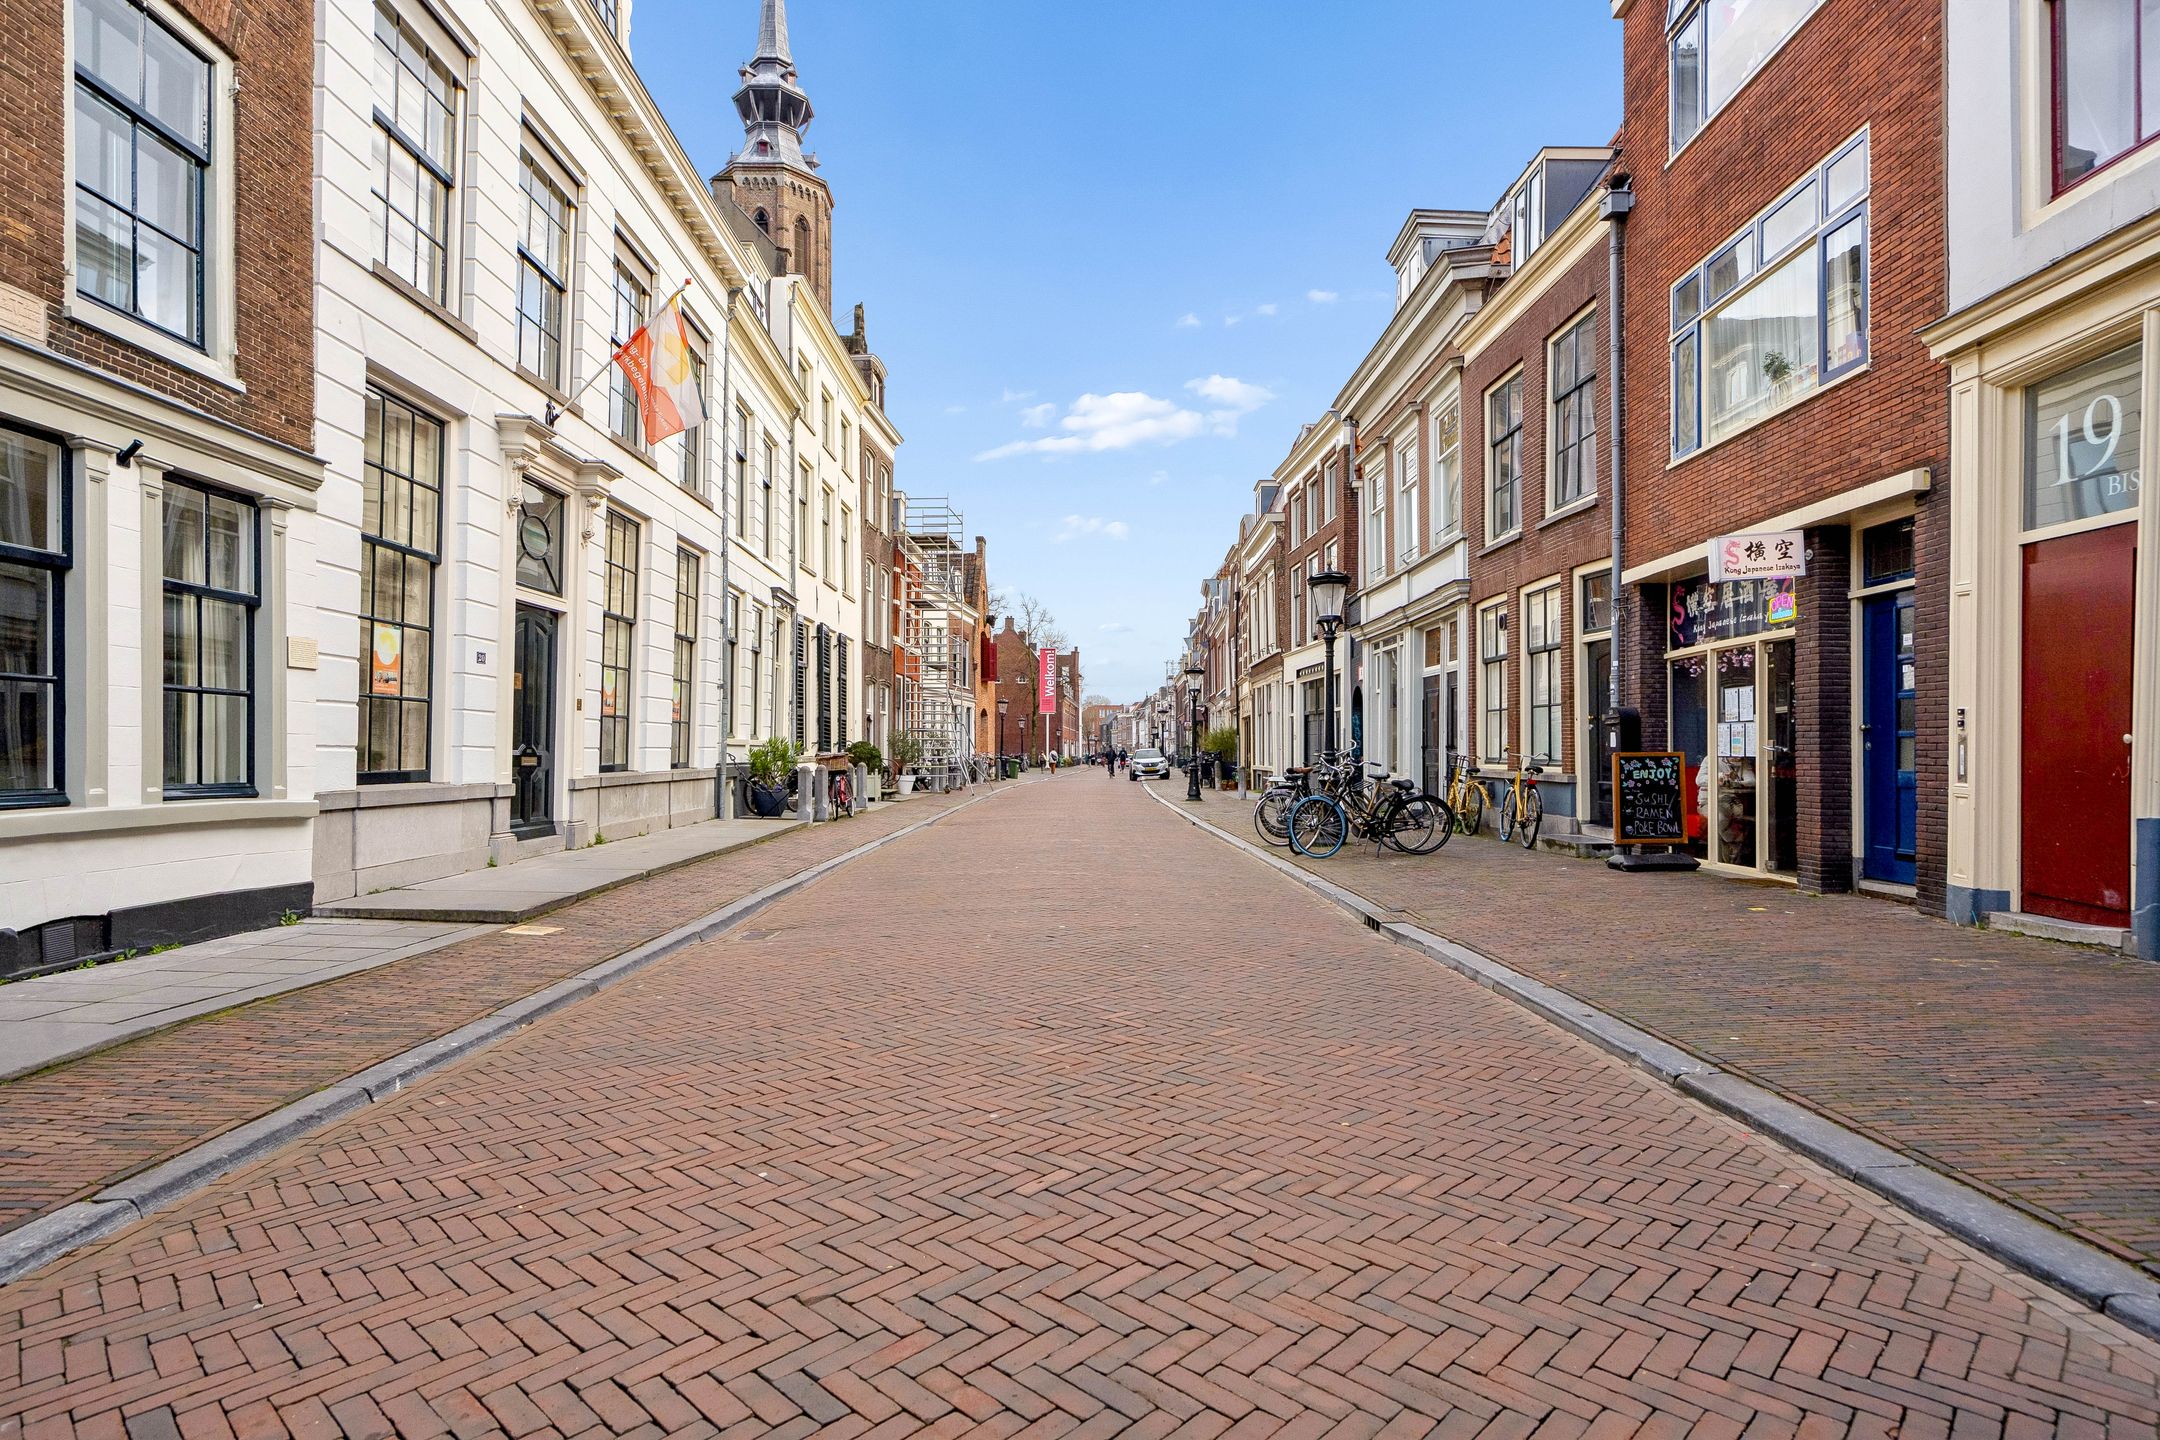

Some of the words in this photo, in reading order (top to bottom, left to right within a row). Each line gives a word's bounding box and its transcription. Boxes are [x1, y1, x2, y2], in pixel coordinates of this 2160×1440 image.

[638, 357, 649, 370] en
[2048, 395, 2122, 487] 19
[2107, 469, 2141, 496] BIS
[1724, 567, 1742, 575] Kong
[1742, 565, 1774, 574] Japanese
[1775, 563, 1801, 572] Izakaya
[1771, 592, 1794, 612] OPEN
[1708, 616, 1737, 630] Japanese
[1740, 611, 1769, 623] Izakay
[1045, 650, 1055, 697] Welkom!
[1633, 768, 1672, 780] ENJOY
[1636, 807, 1673, 819] RAMEN
